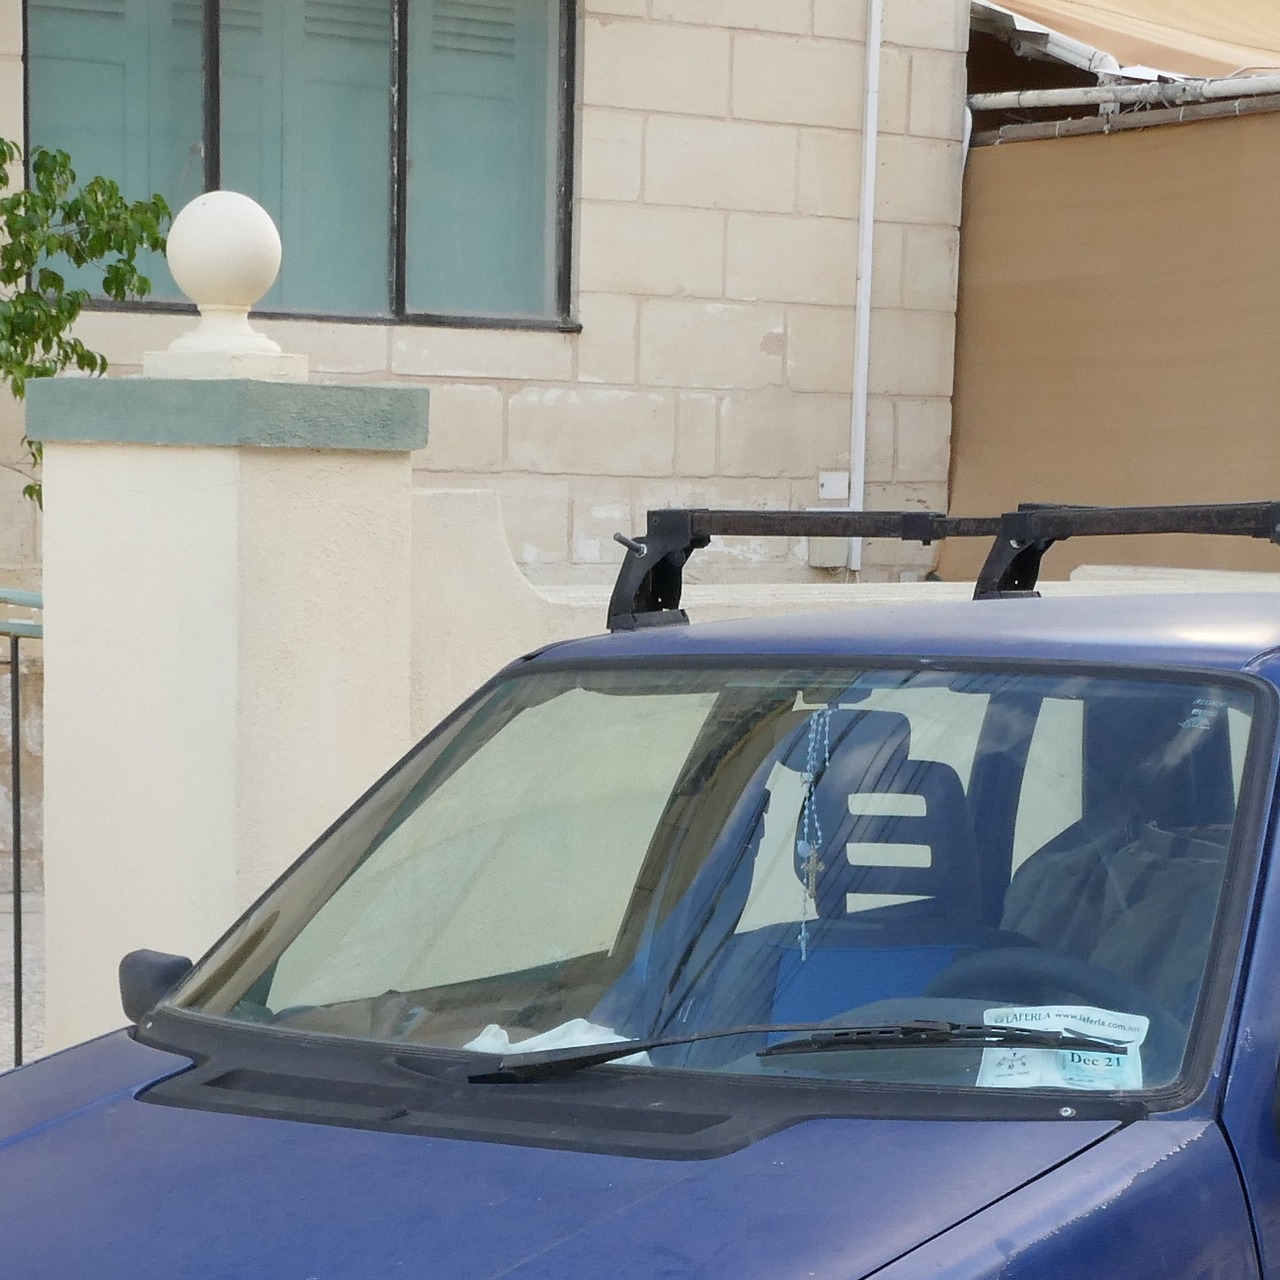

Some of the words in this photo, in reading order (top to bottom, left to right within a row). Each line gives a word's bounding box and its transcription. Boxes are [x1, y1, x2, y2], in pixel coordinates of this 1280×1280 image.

[1005, 1012, 1051, 1024] LAFERLA
[1070, 1052, 1099, 1066] Dec
[1105, 1057, 1121, 1067] 21
